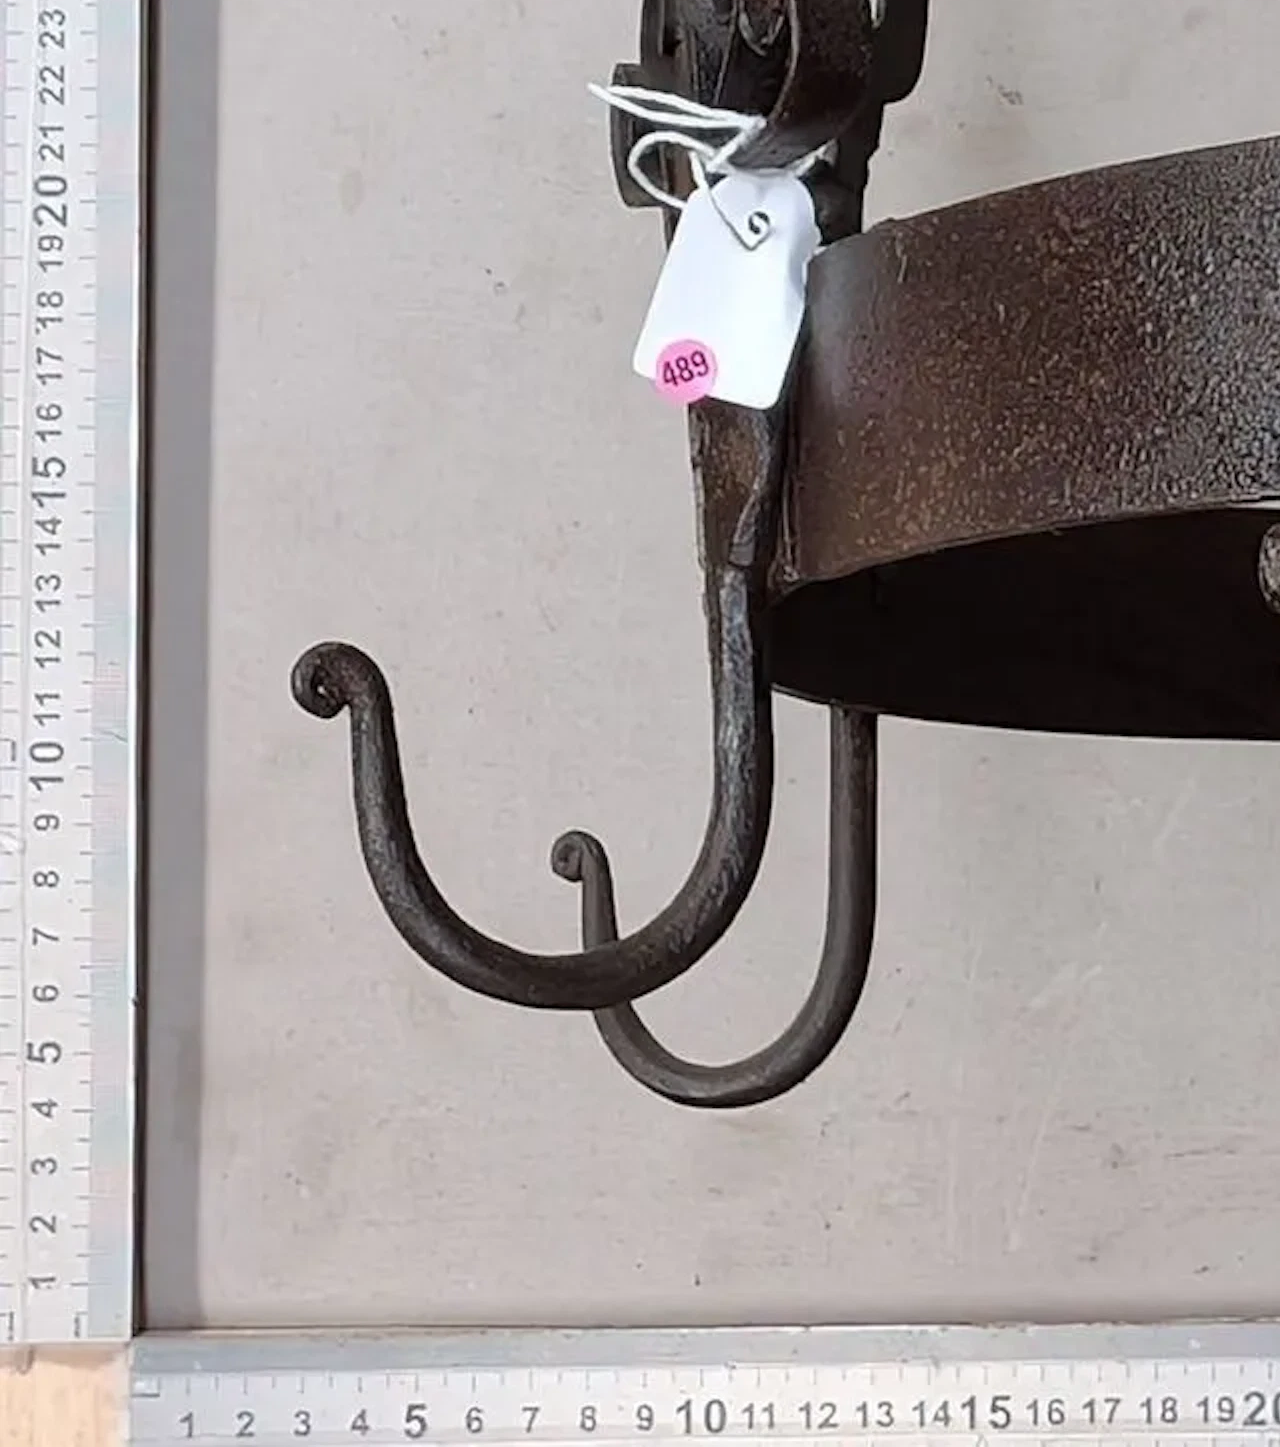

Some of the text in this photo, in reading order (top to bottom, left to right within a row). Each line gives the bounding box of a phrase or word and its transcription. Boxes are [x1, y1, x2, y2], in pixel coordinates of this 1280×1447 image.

[38, 9, 66, 49] 23
[38, 66, 64, 105] 22
[37, 126, 64, 161] 21
[33, 175, 67, 227] 20
[38, 235, 64, 272] 19
[36, 291, 63, 329] 18
[36, 347, 63, 386] 17
[663, 351, 709, 387] 489
[35, 404, 62, 442] 16
[31, 456, 66, 508] 15
[35, 517, 62, 556] 14
[35, 574, 61, 612] 13
[34, 630, 61, 668] 12
[33, 693, 60, 726] 11
[29, 742, 64, 791] 10
[33, 814, 59, 831] 9
[33, 871, 59, 888] 8
[32, 928, 59, 945] 7
[32, 985, 59, 1002] 6
[26, 1042, 61, 1063] 5
[31, 1099, 58, 1118] 4
[30, 1157, 57, 1175] 3
[29, 1216, 56, 1233] 2
[28, 1277, 56, 1289] 1
[180, 1412, 193, 1439] 1
[236, 1411, 254, 1438] 2
[294, 1410, 311, 1436] 3
[351, 1409, 370, 1435] 4
[405, 1404, 427, 1440] 5
[466, 1407, 483, 1434] 6
[522, 1407, 540, 1434] 7
[579, 1406, 597, 1433] 8
[636, 1404, 653, 1431] 9
[676, 1399, 726, 1435] 10
[742, 1403, 775, 1430] 11
[799, 1402, 839, 1430] 12
[856, 1401, 894, 1428] 13
[912, 1400, 951, 1428] 14
[961, 1395, 1011, 1430] 15
[1027, 1399, 1065, 1426] 16
[1082, 1398, 1121, 1425] 17
[1140, 1397, 1178, 1424] 18
[1197, 1396, 1235, 1424] 19
